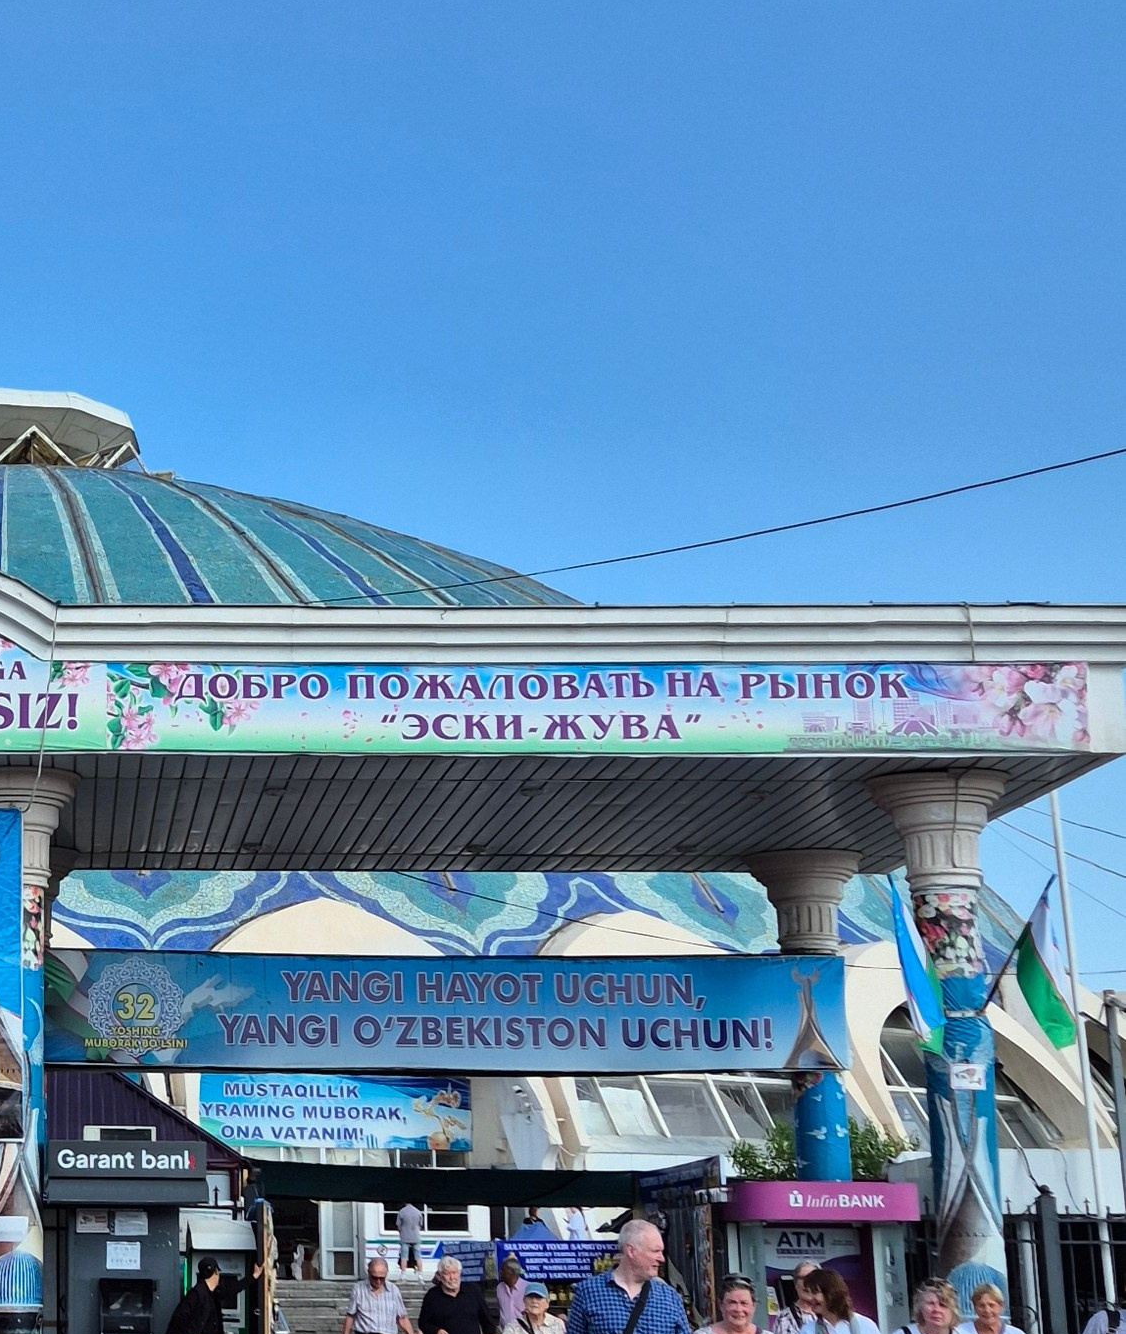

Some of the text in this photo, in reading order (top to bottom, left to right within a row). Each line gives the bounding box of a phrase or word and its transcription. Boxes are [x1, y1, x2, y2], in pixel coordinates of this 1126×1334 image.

[174, 671, 910, 704] ДОБРО ПОЖАЛОВАТЬ НА РЫНОК
[380, 713, 702, 741] "ЭСКИ-ЖУВА"
[281, 971, 706, 1010] YANGI HAYOT UCHUN,
[117, 993, 156, 1020] 32
[110, 1027, 161, 1036] YOSHING
[217, 1014, 774, 1051] YANGI O'ZBEKISTON UCHUN!
[84, 1038, 138, 1048] MUBORAK
[224, 1082, 359, 1099] MUSTAQILLIK
[199, 1103, 407, 1124] YRAMING MUBORAK,
[221, 1125, 364, 1141] ONA VATANIM!
[57, 1149, 196, 1170] Garant bank
[806, 1194, 885, 1208] InfinBANK
[777, 1231, 825, 1248] ATM
